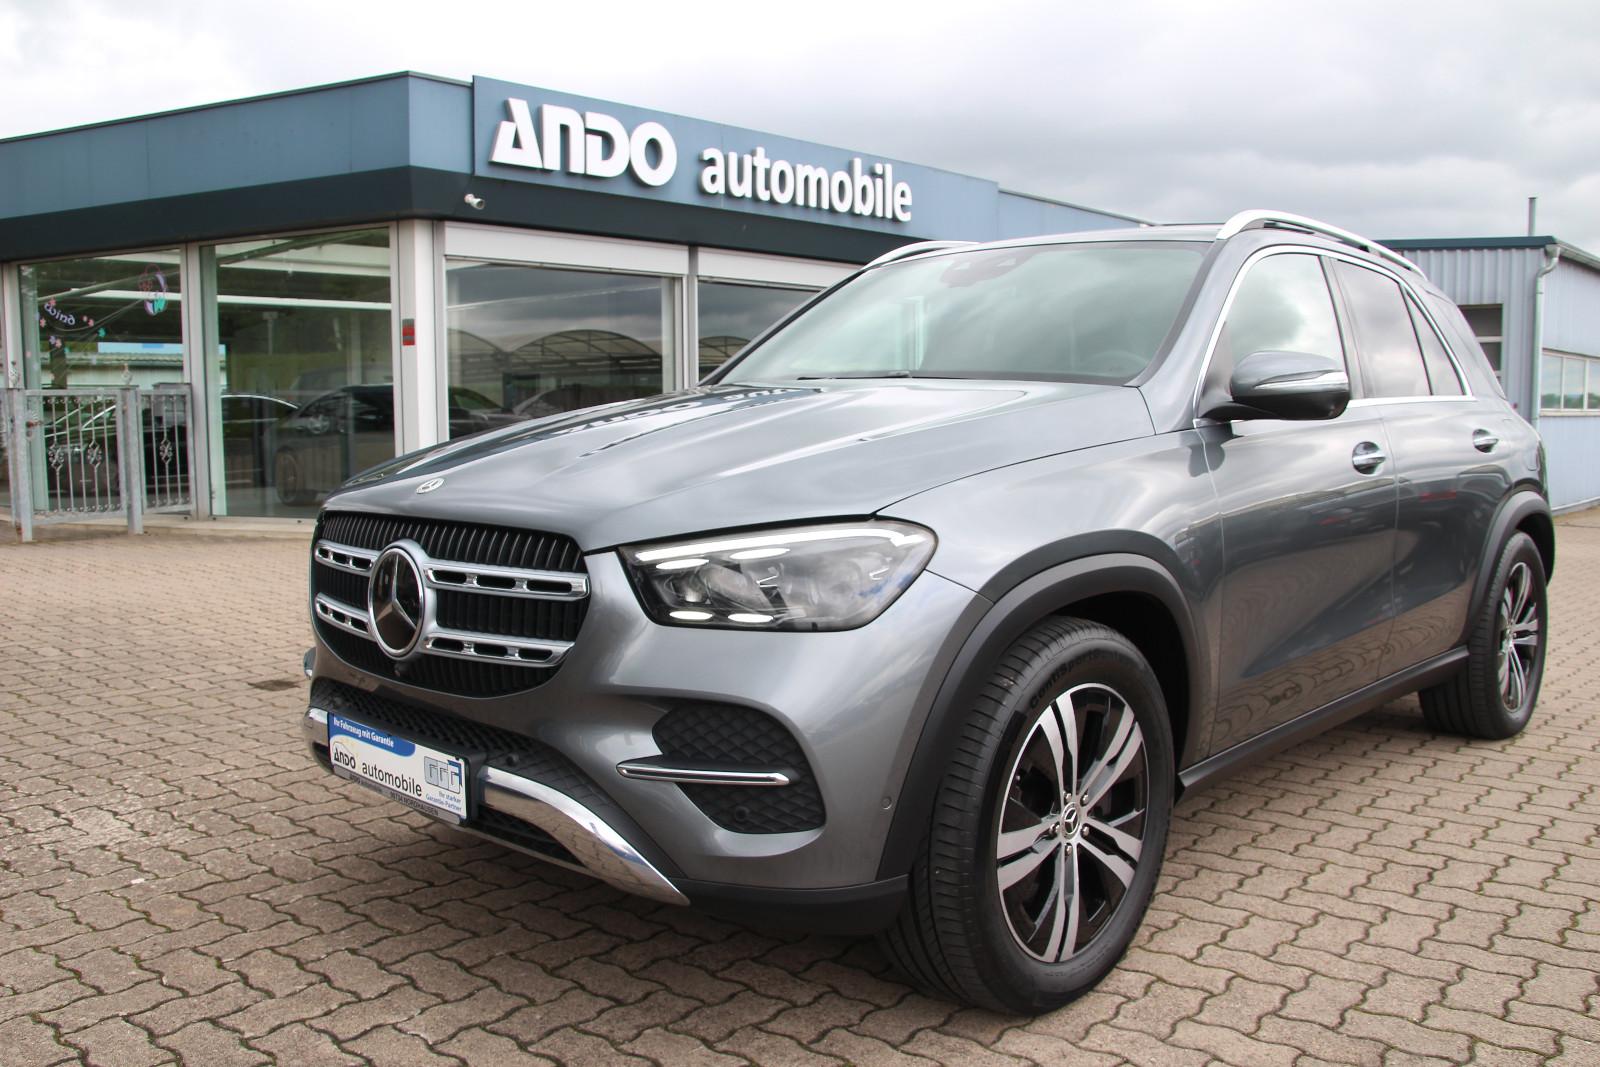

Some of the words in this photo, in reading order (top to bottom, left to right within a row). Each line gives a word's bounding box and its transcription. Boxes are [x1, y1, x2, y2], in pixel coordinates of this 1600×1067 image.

[489, 97, 677, 187] ANDO
[700, 146, 912, 222] automobile
[362, 729, 371, 740] mit
[371, 732, 394, 748] Garantie
[334, 748, 356, 769] ANDO
[362, 762, 422, 797] automobile
